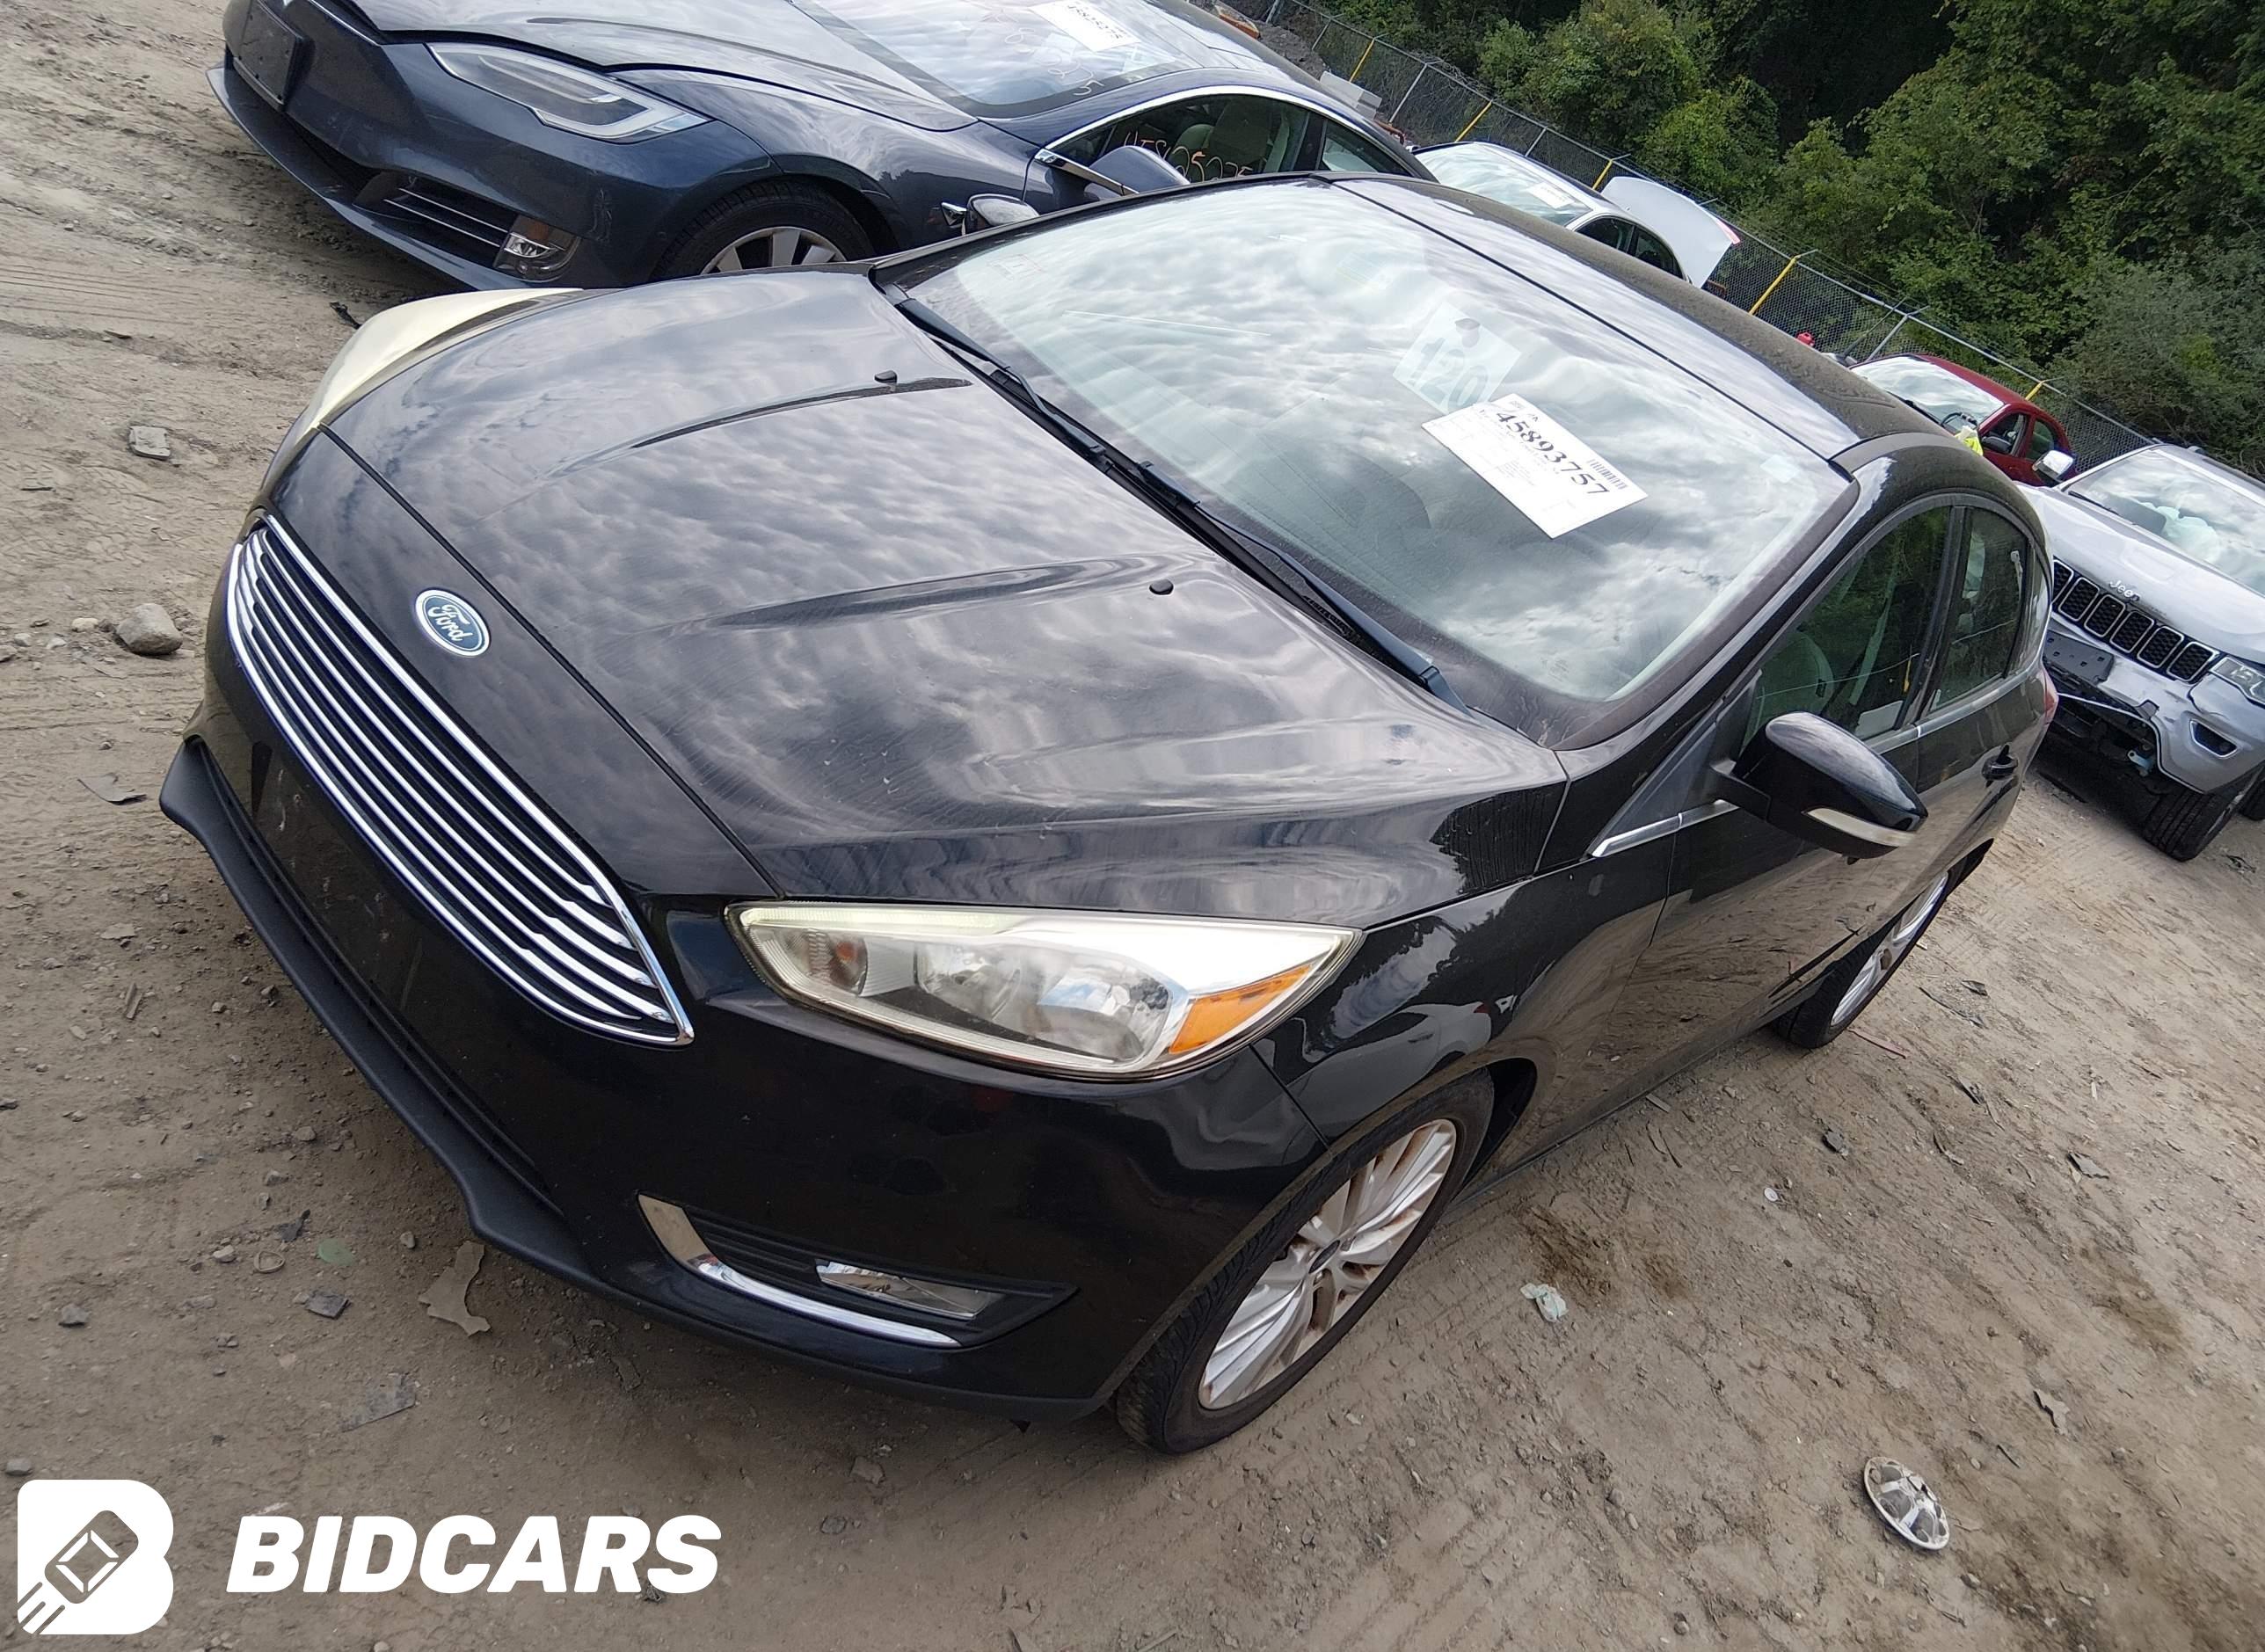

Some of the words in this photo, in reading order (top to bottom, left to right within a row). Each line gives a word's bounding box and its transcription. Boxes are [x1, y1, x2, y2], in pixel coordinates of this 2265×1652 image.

[1496, 411, 1611, 495] 45893757
[2109, 580, 2140, 601] Jeep
[427, 604, 474, 641] Ford
